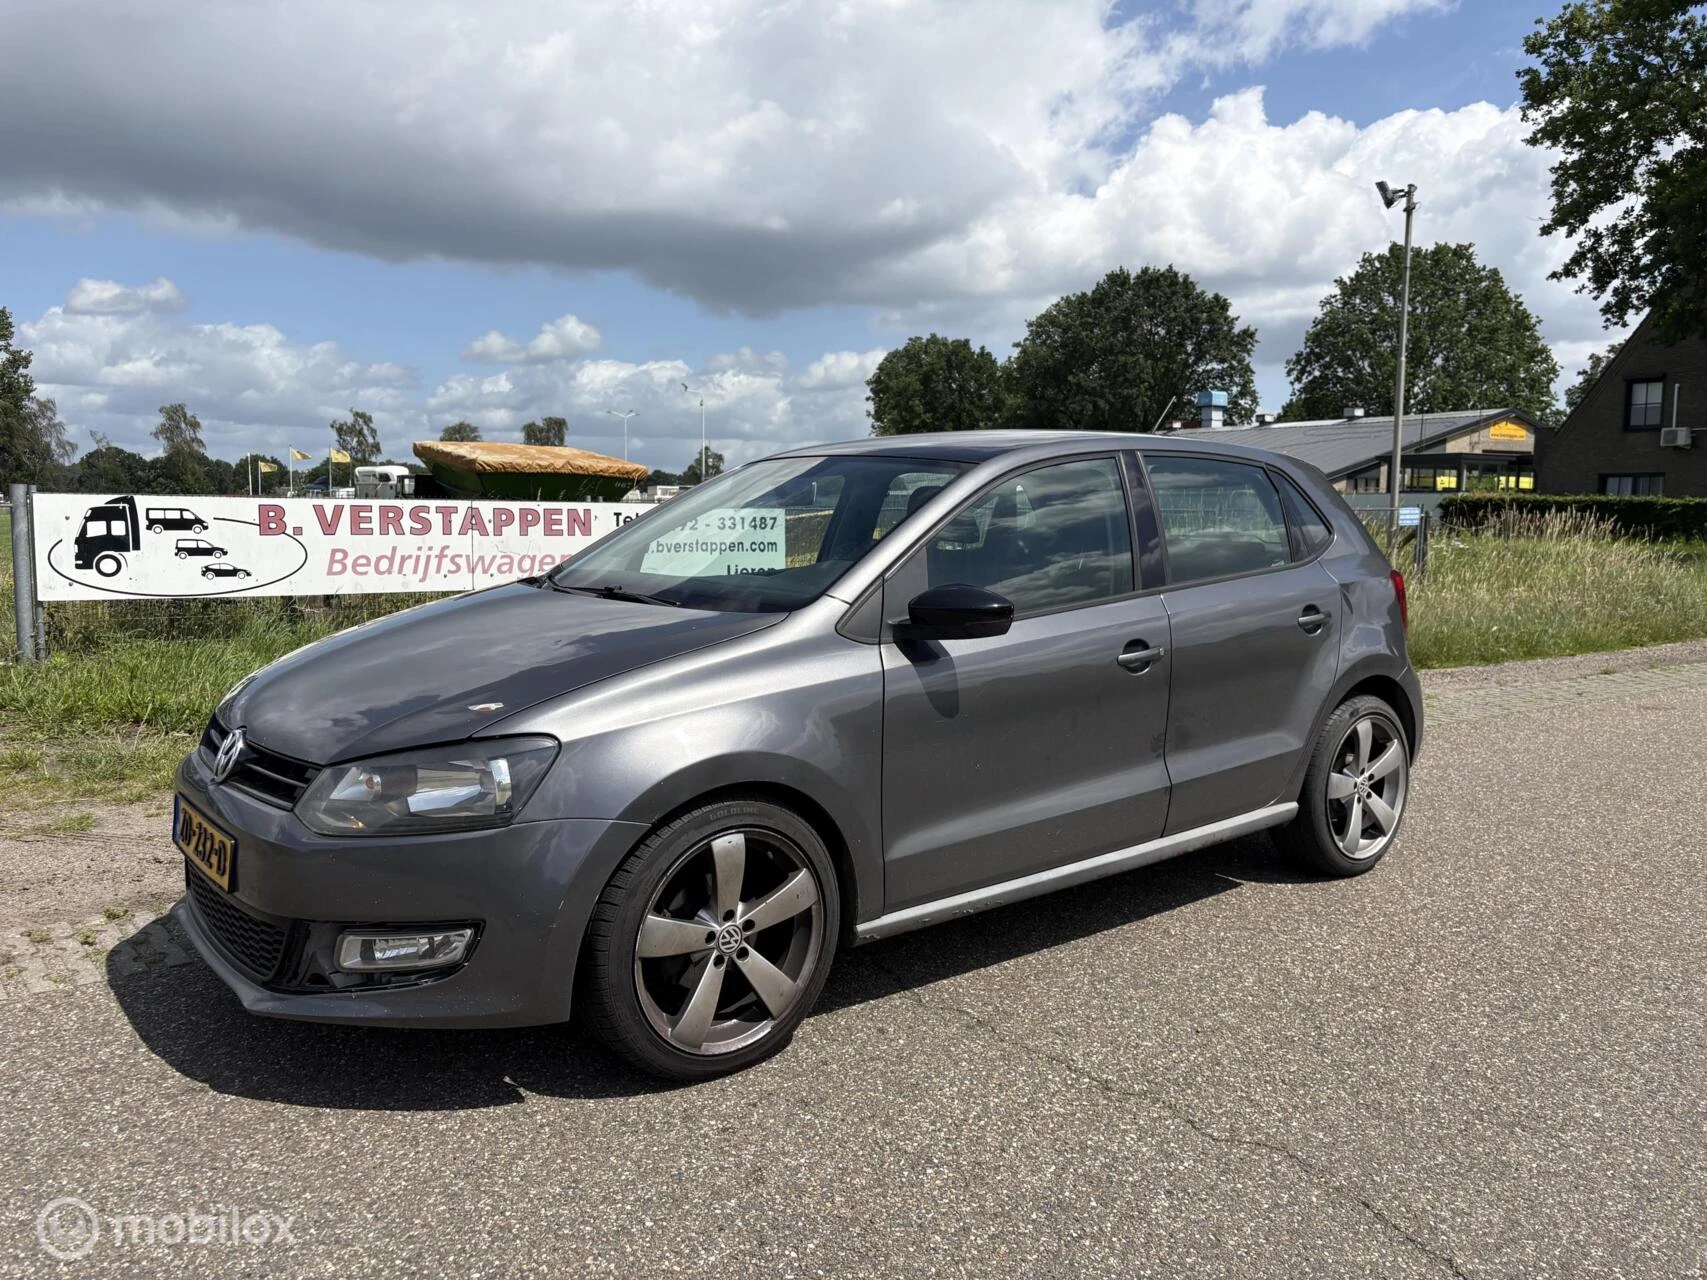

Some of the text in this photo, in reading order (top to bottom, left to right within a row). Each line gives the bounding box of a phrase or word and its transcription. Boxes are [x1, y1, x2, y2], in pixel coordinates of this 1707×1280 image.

[258, 504, 592, 537] B. VERSTAPPEN
[718, 516, 777, 531] 331487
